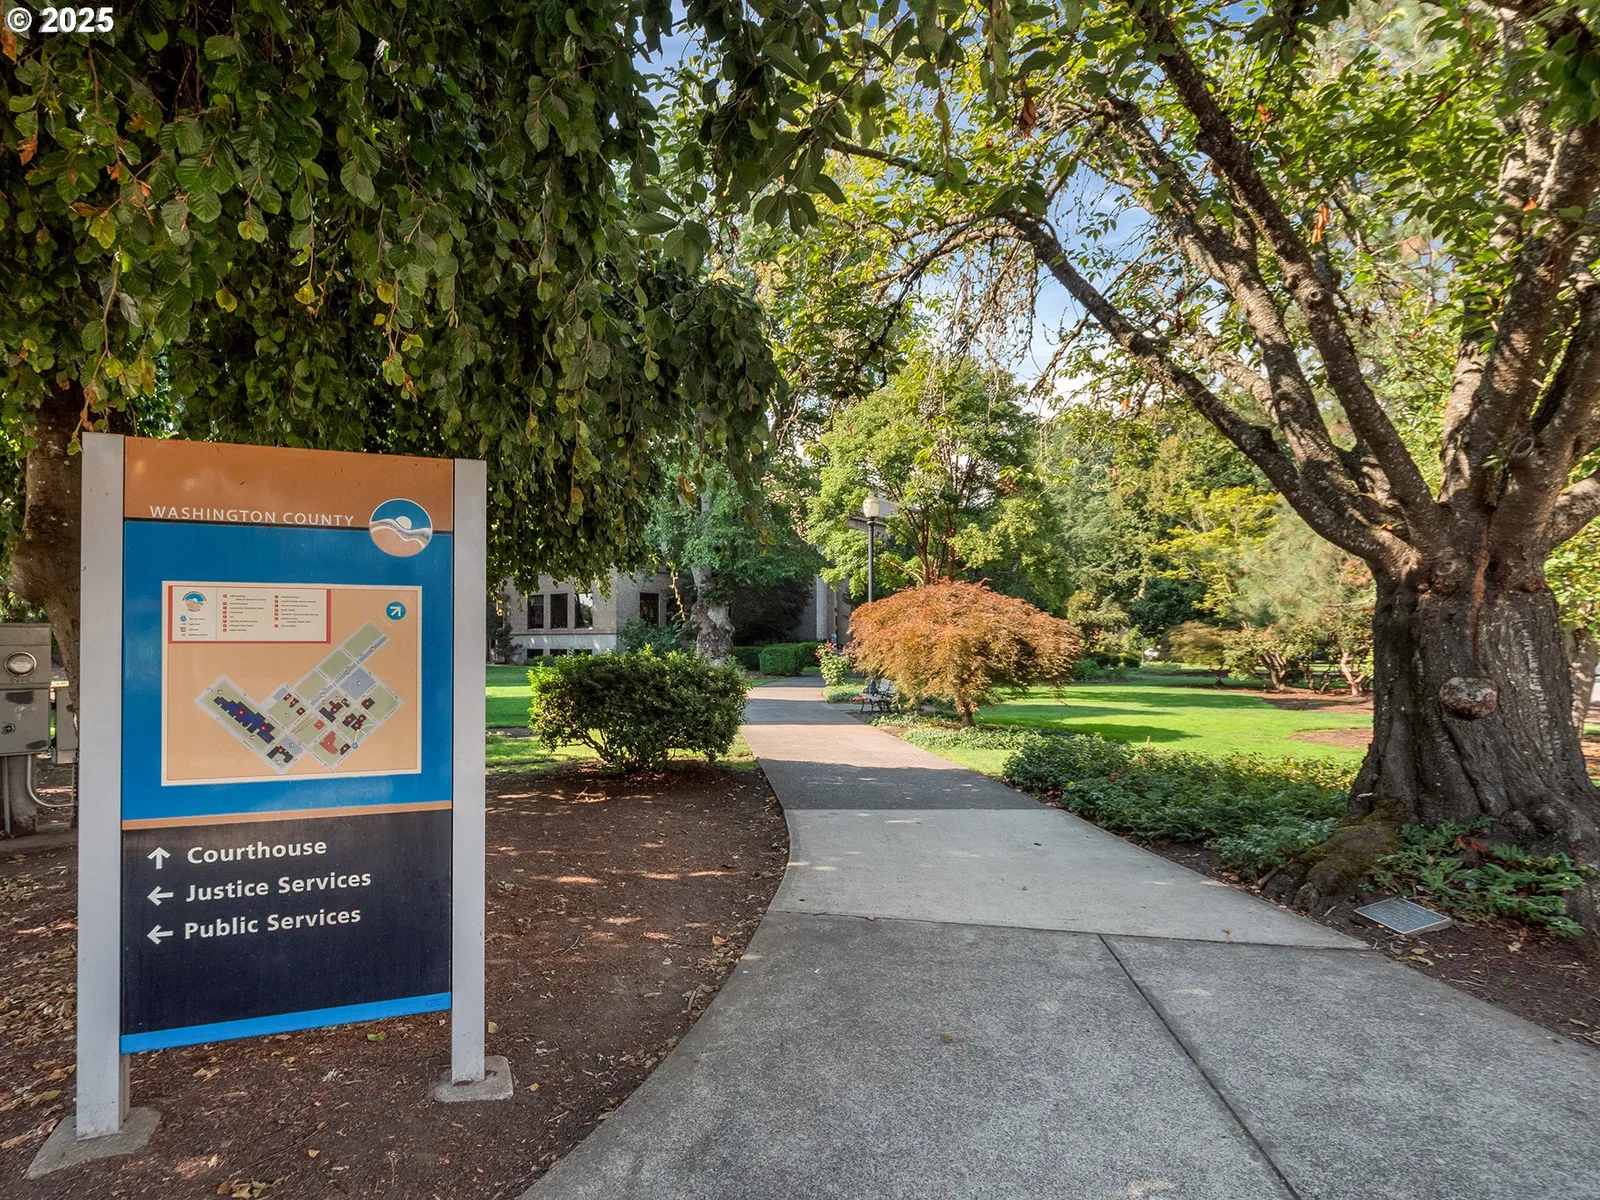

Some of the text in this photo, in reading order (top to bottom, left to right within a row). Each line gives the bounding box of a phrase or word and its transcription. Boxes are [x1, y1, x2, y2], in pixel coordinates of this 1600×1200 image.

[150, 505, 354, 527] WASHINGTON COUNTY
[187, 841, 327, 864] Courthouse
[185, 871, 371, 902] Justice Services
[184, 907, 361, 940] Public Services
